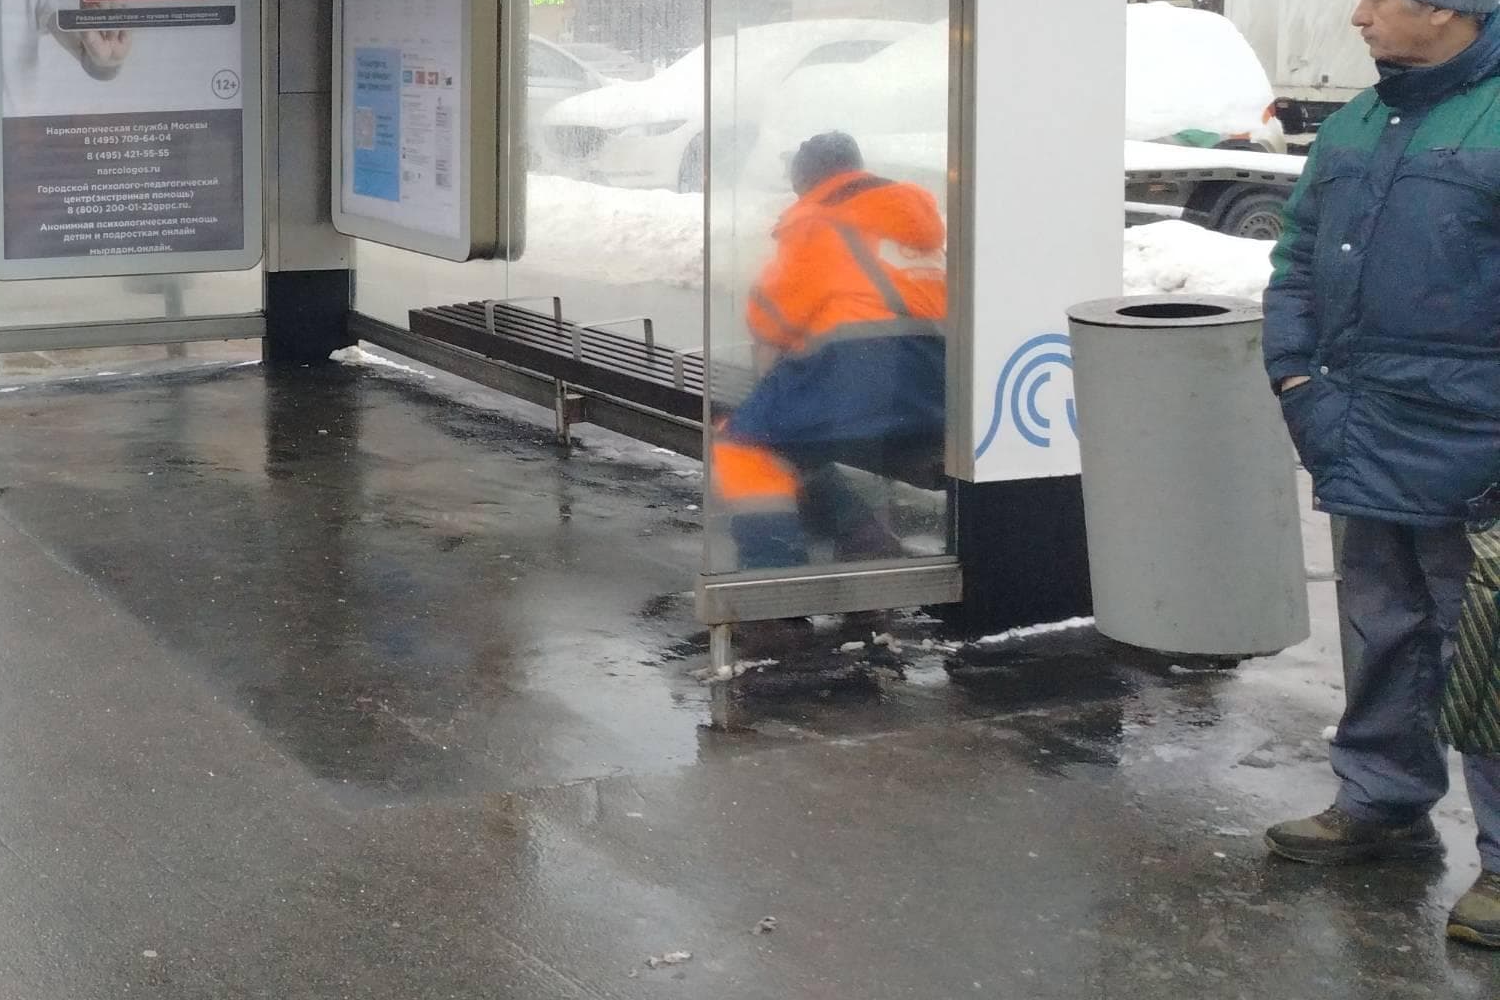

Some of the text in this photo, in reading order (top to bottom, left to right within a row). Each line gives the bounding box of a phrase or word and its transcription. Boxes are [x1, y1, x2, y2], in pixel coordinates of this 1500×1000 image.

[216, 79, 236, 90] 12+
[46, 122, 208, 137] Наркологическая служба Москвы
[93, 136, 119, 145] (495)
[86, 152, 93, 160] 8
[95, 151, 121, 160] (495)
[97, 166, 161, 176] narcologos.ru
[37, 178, 219, 194] Городской психолого-педагогический
[67, 207, 74, 215] 8
[76, 205, 103, 215] (800)
[40, 216, 218, 232] Анонимная психологическая помощь
[64, 232, 92, 242] детям
[103, 229, 159, 240] подросткам
[162, 227, 196, 236] онлайн
